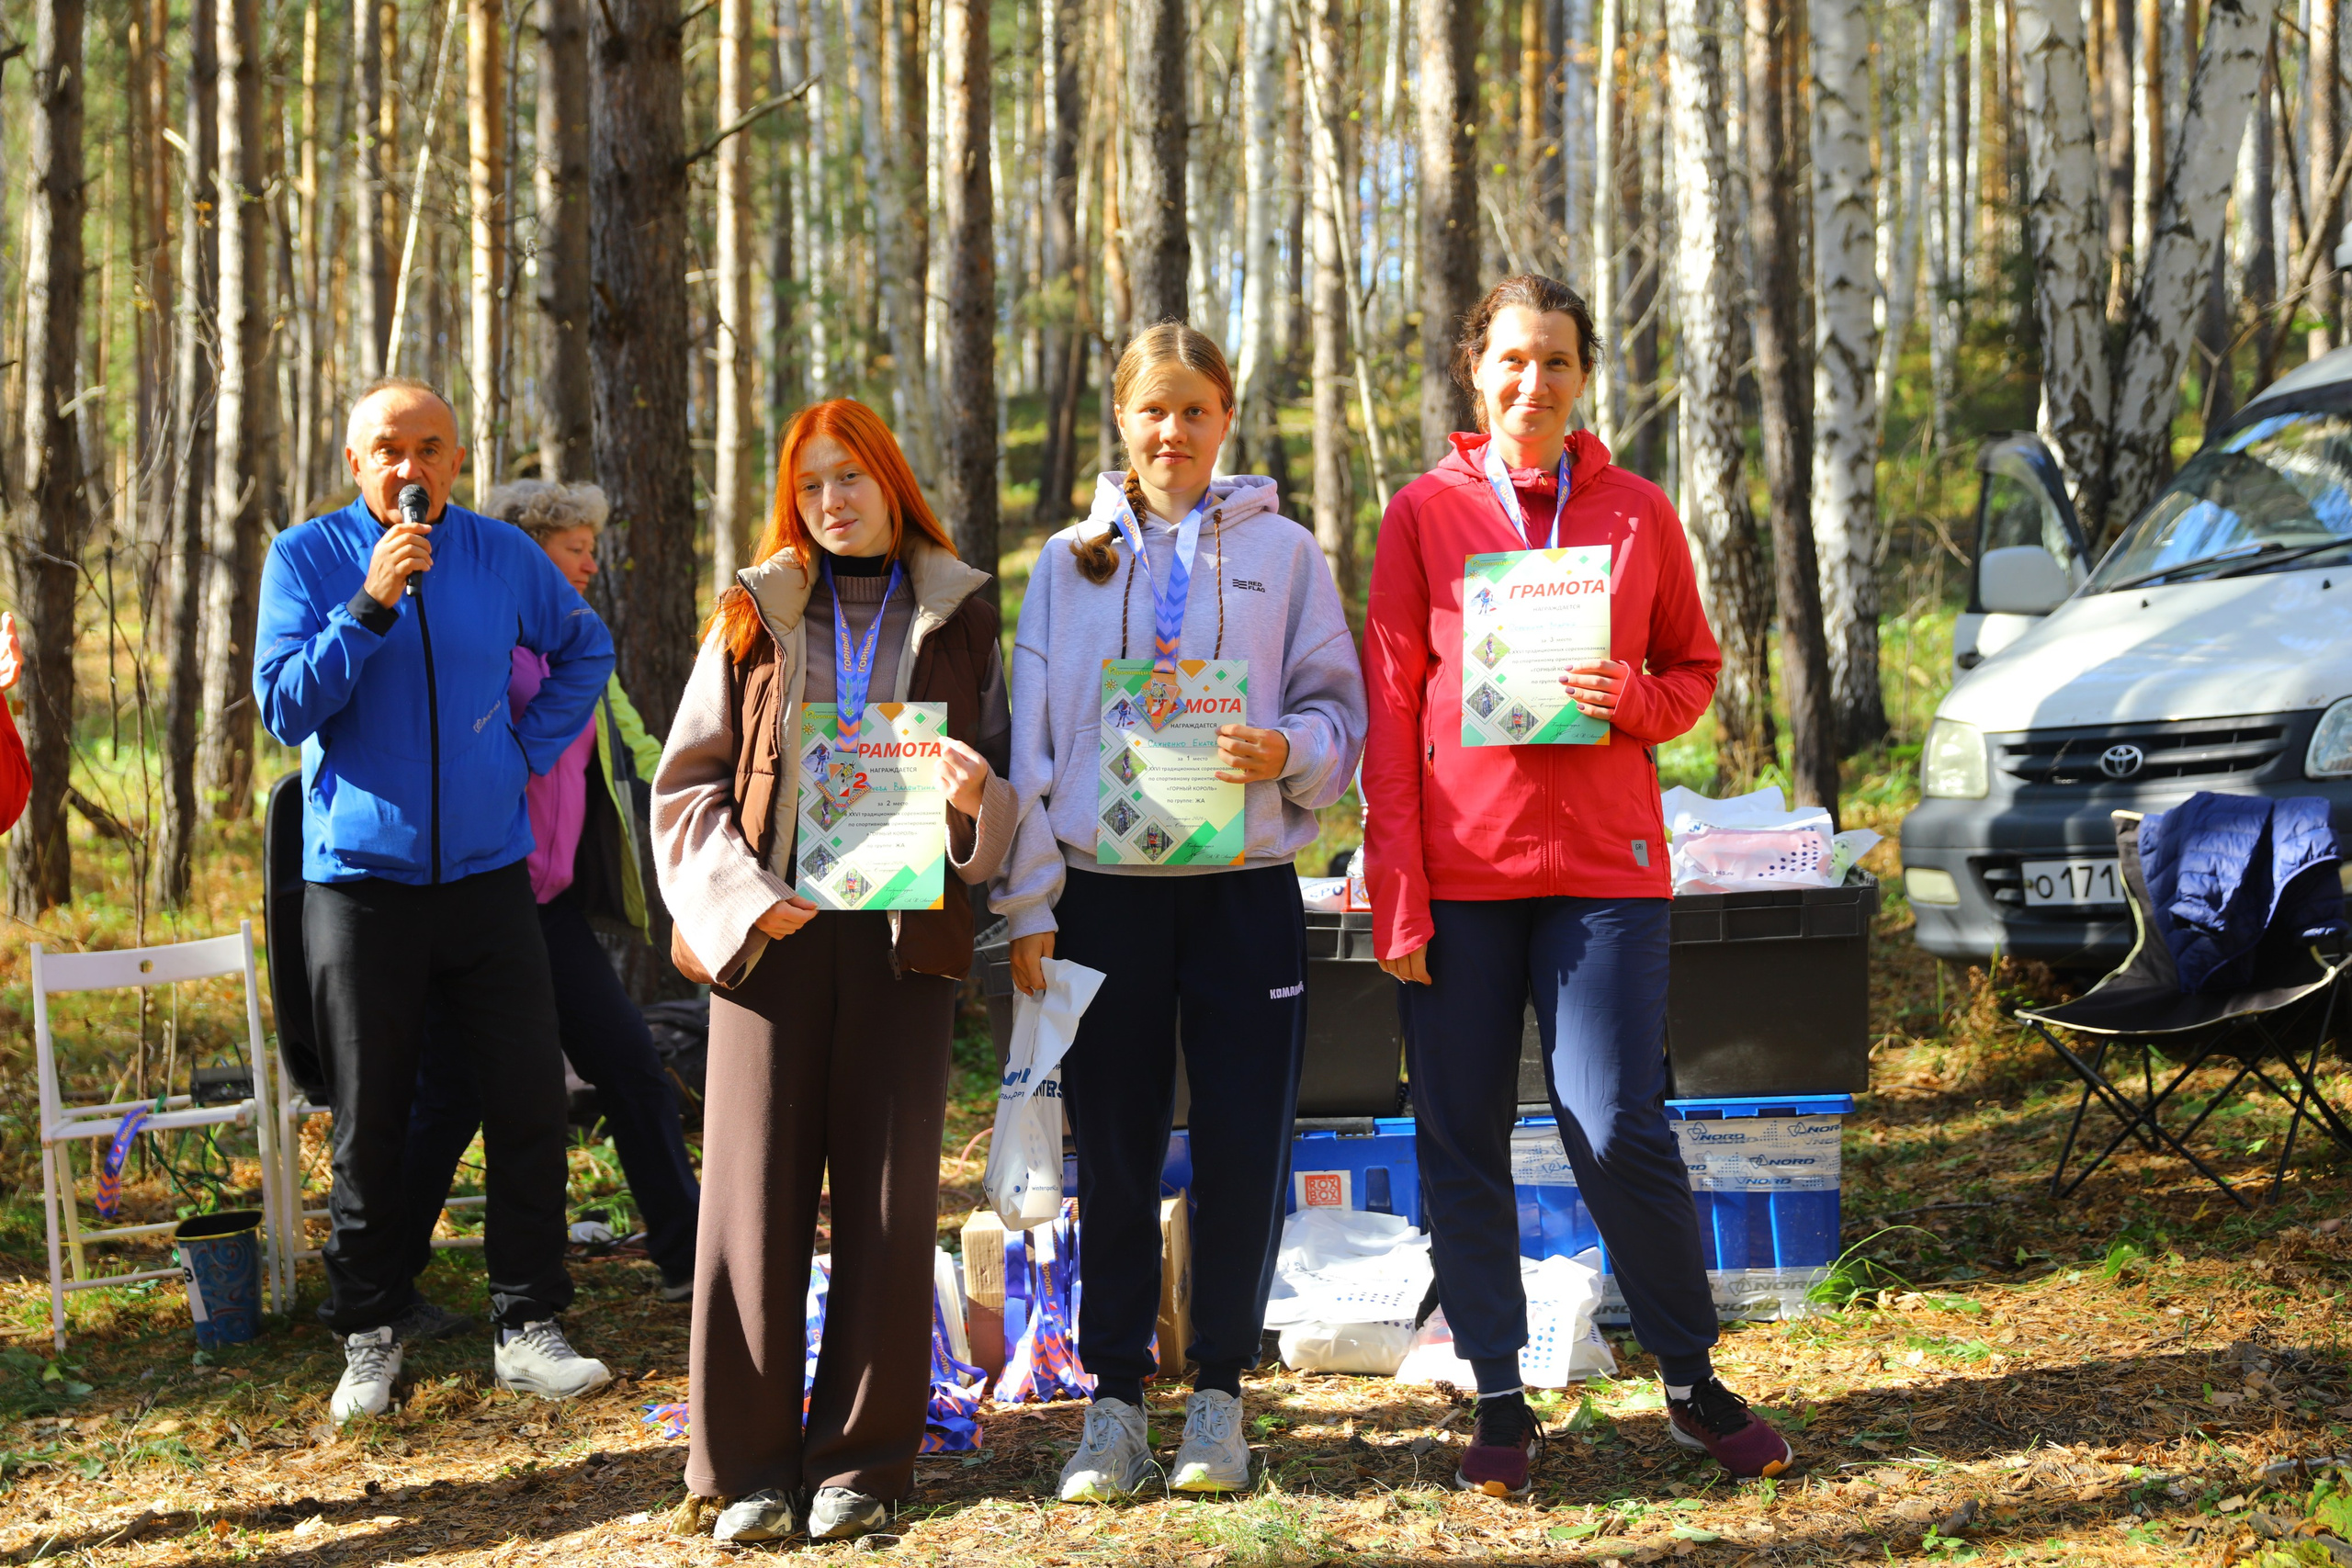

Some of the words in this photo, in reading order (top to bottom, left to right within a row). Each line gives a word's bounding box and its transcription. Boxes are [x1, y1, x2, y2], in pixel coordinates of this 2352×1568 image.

[1510, 579, 1605, 599] ГРАМОТА
[1533, 604, 1581, 612] НАГРАЖДАЕТСЯ
[858, 742, 942, 759] РАМОТА
[853, 772, 867, 789] 2
[1807, 1124, 1840, 1134] NOR
[1700, 1133, 1745, 1141] NORD
[1309, 1179, 1338, 1190] ROX
[1310, 1190, 1339, 1201] BOX
